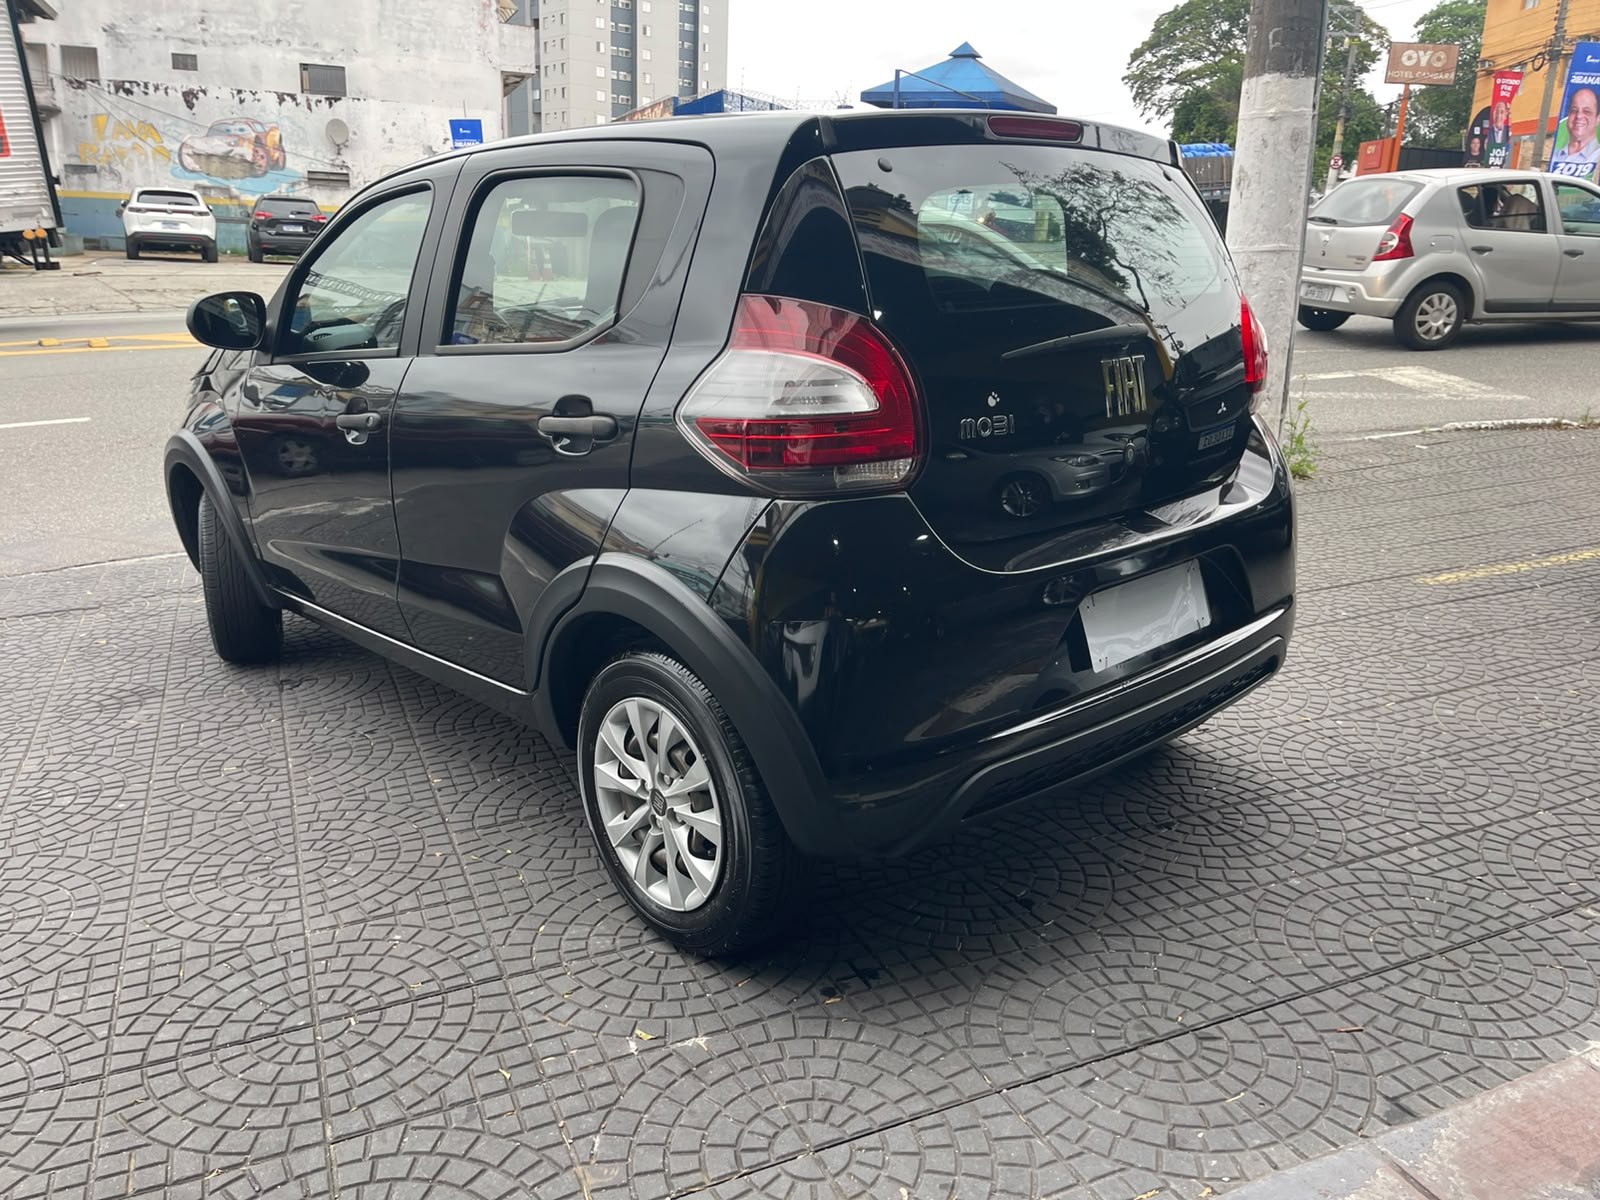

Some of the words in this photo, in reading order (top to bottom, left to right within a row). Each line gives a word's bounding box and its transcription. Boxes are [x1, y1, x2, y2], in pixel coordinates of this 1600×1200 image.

[1401, 49, 1448, 68] OYO
[1388, 70, 1414, 79] HOTEL
[1553, 162, 1594, 177] 2019
[1100, 355, 1147, 418] FIAT
